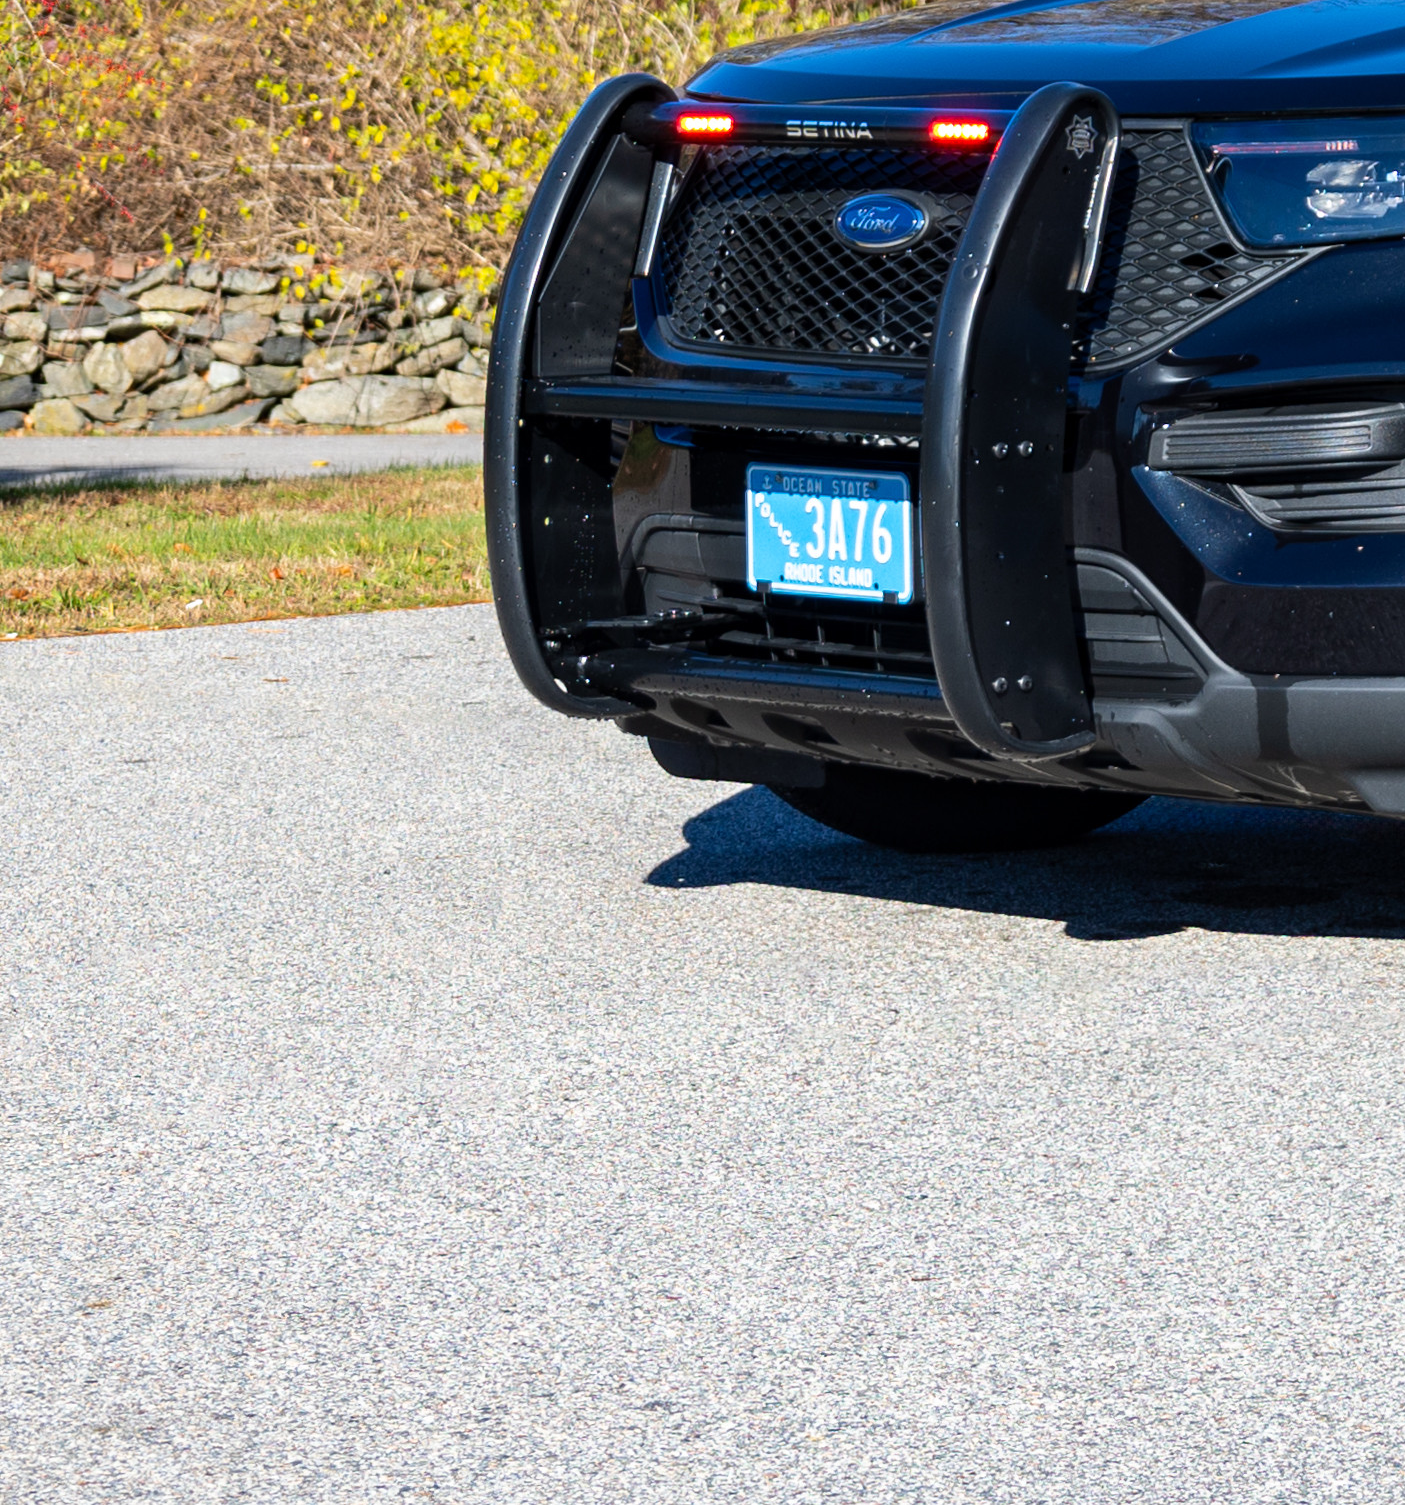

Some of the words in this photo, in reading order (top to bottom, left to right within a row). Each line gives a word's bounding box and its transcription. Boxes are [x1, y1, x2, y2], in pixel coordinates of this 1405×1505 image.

[786, 120, 873, 139] SETINA
[850, 205, 900, 234] Ford
[783, 476, 822, 493] OCEAN
[832, 479, 870, 498] STATE
[755, 493, 800, 558] POLICE
[805, 498, 893, 564] 3A76
[784, 562, 824, 584] RHODE
[828, 565, 873, 588] ISLAND
